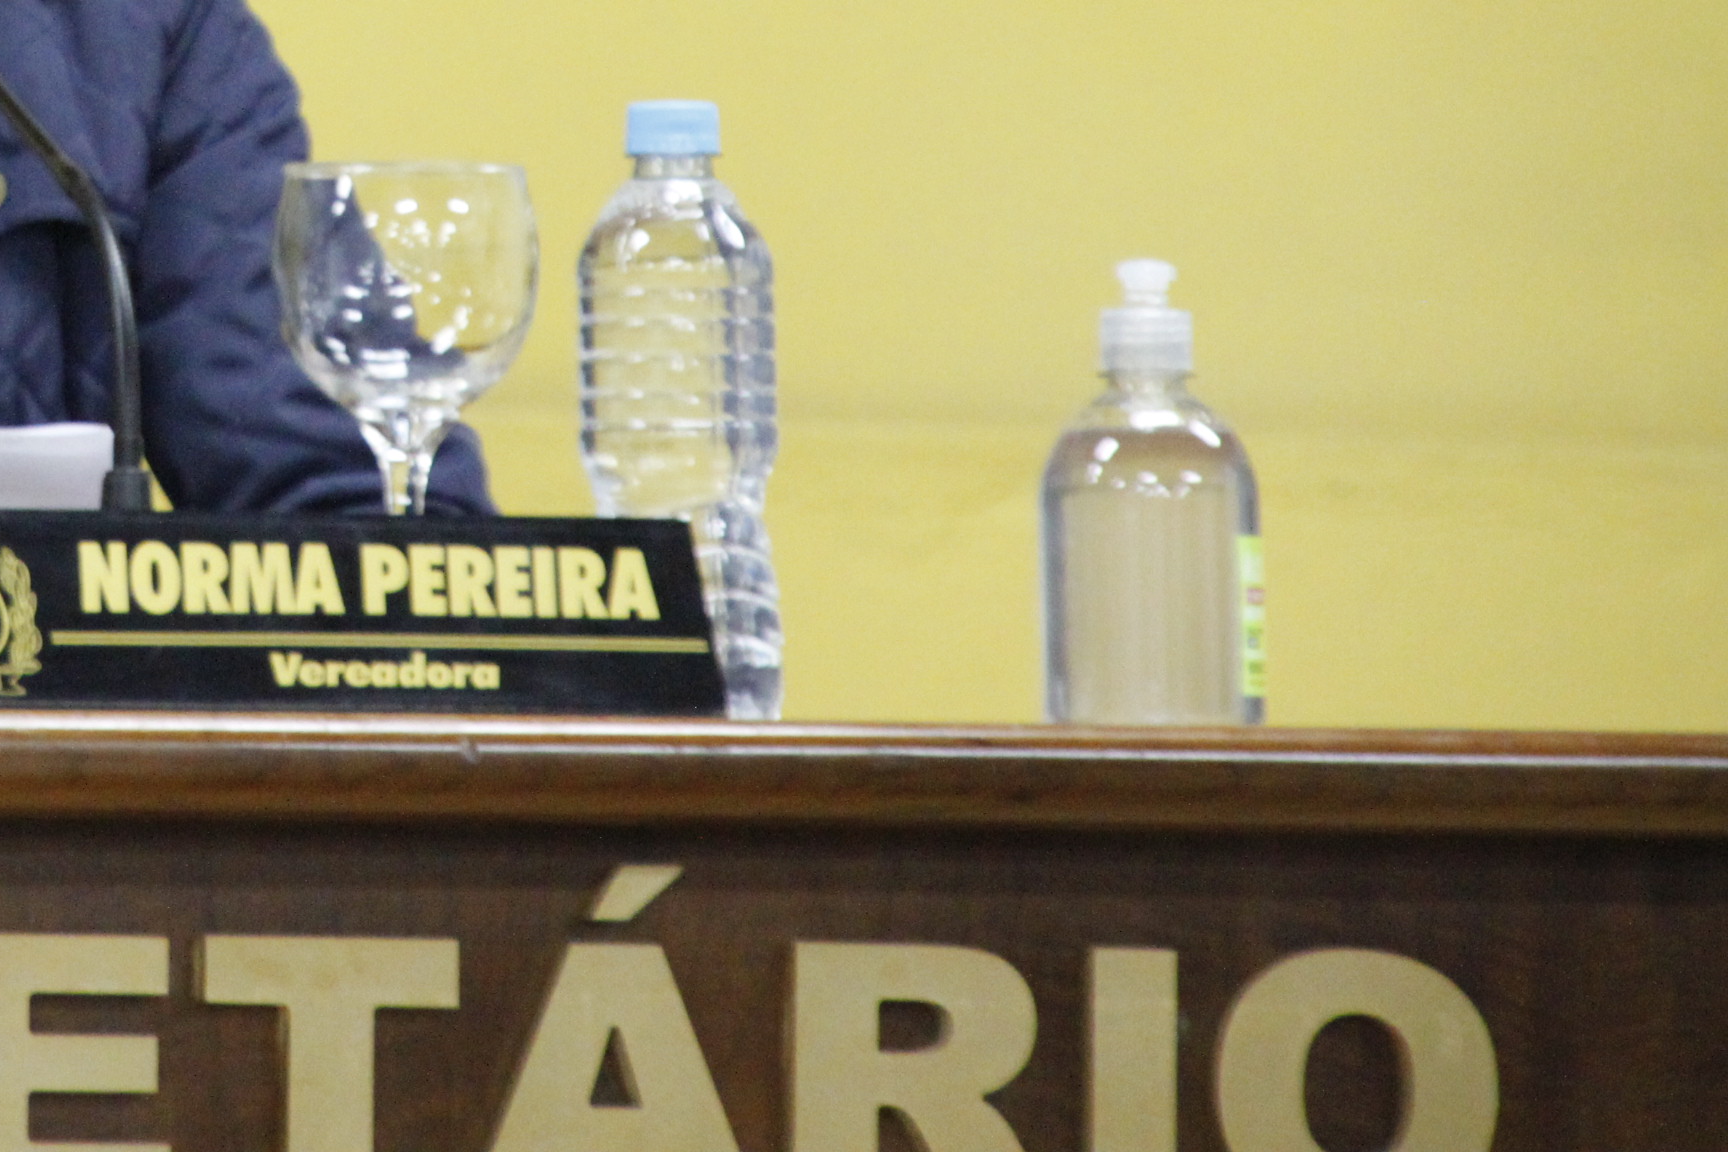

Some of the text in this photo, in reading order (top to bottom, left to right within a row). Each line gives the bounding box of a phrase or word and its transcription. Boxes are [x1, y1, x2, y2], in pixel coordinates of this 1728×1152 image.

[76, 539, 662, 621] NORMA PEREIRA
[268, 650, 502, 690] Vereadora
